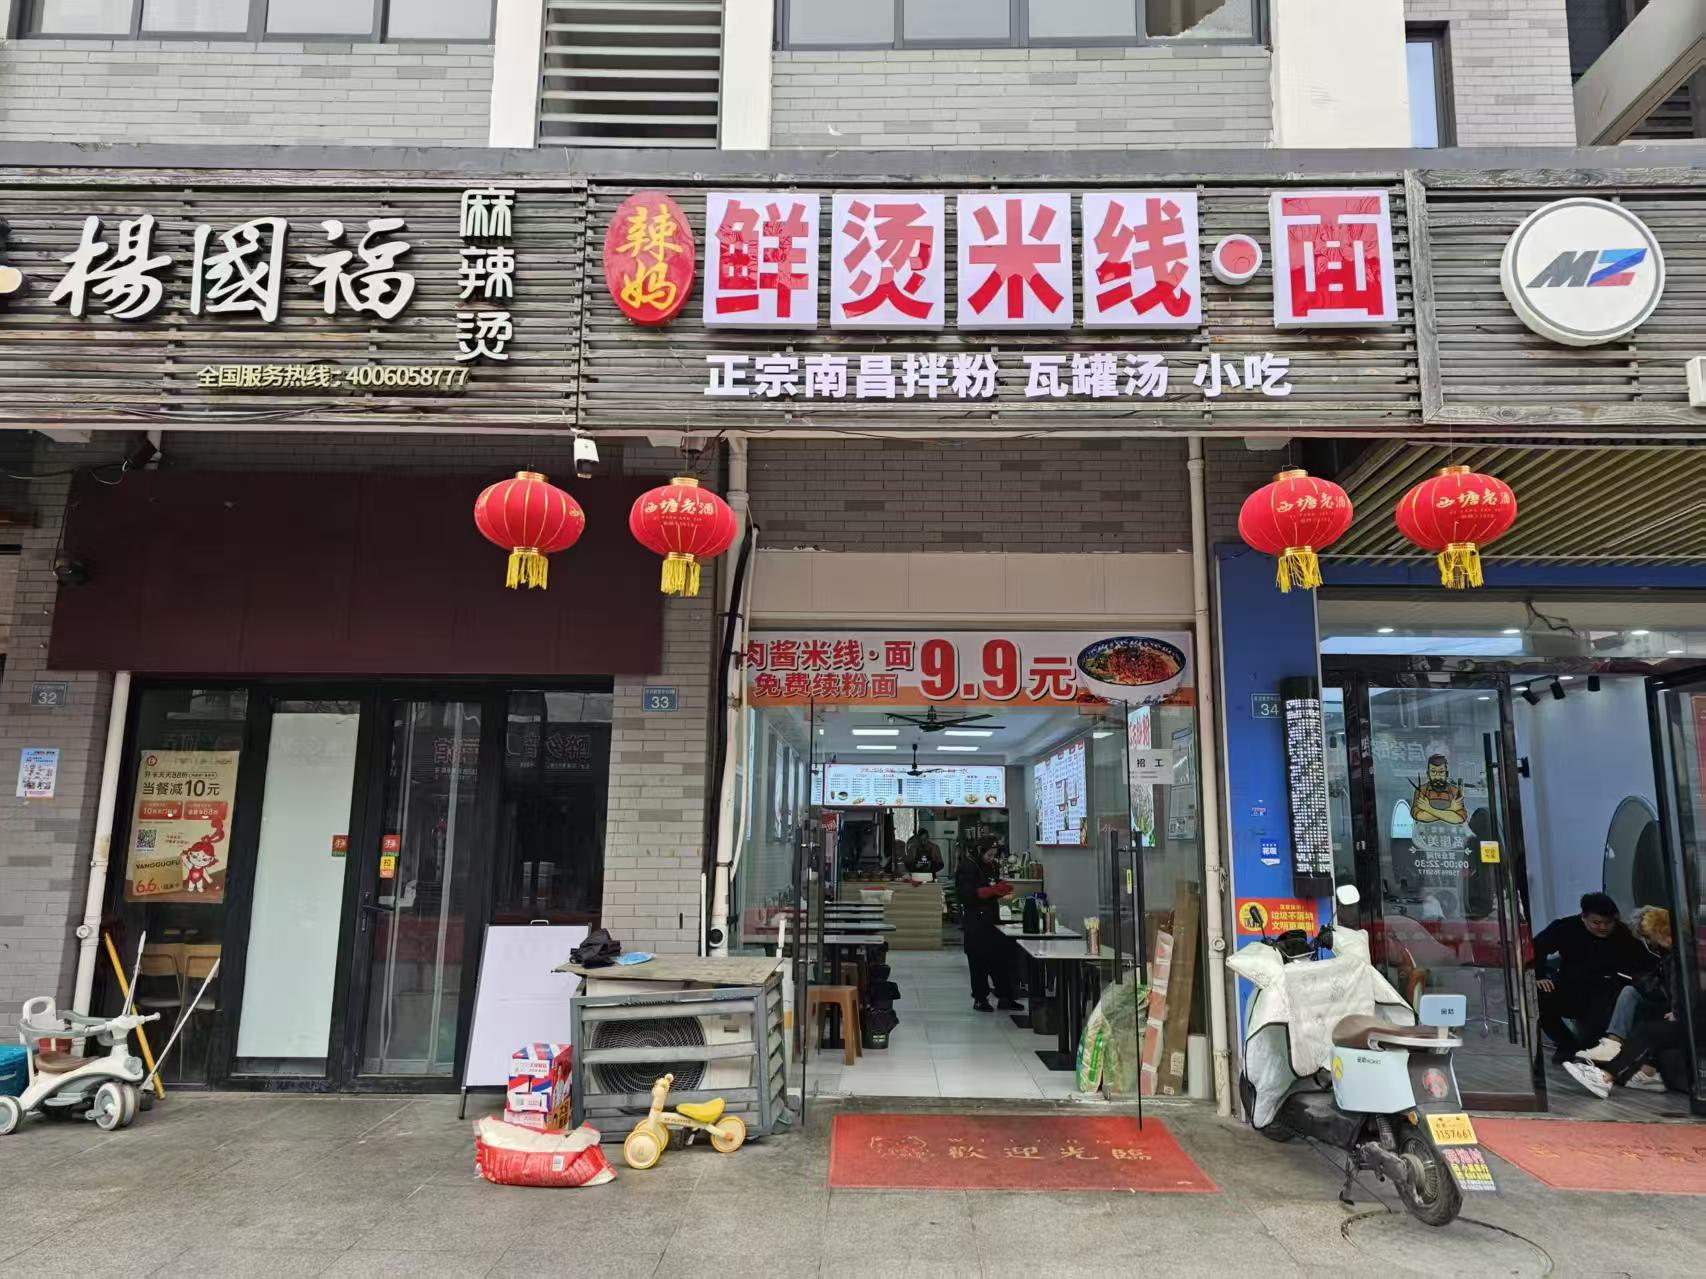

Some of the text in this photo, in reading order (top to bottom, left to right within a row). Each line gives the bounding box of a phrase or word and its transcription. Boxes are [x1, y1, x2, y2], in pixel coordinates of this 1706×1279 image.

[49, 214, 416, 323] 楊國福
[455, 187, 516, 362] 麻辣烫
[616, 203, 683, 310] 辣妈
[703, 352, 1293, 399] 正宗南昌拌粉 瓦罐汤 小吃
[754, 672, 897, 698] 免费续粉面
[920, 637, 1075, 699] 9.9元
[38, 691, 57, 705] 32
[651, 696, 669, 709] 33
[1260, 703, 1279, 716] 34
[142, 779, 220, 797] 当餐减10元
